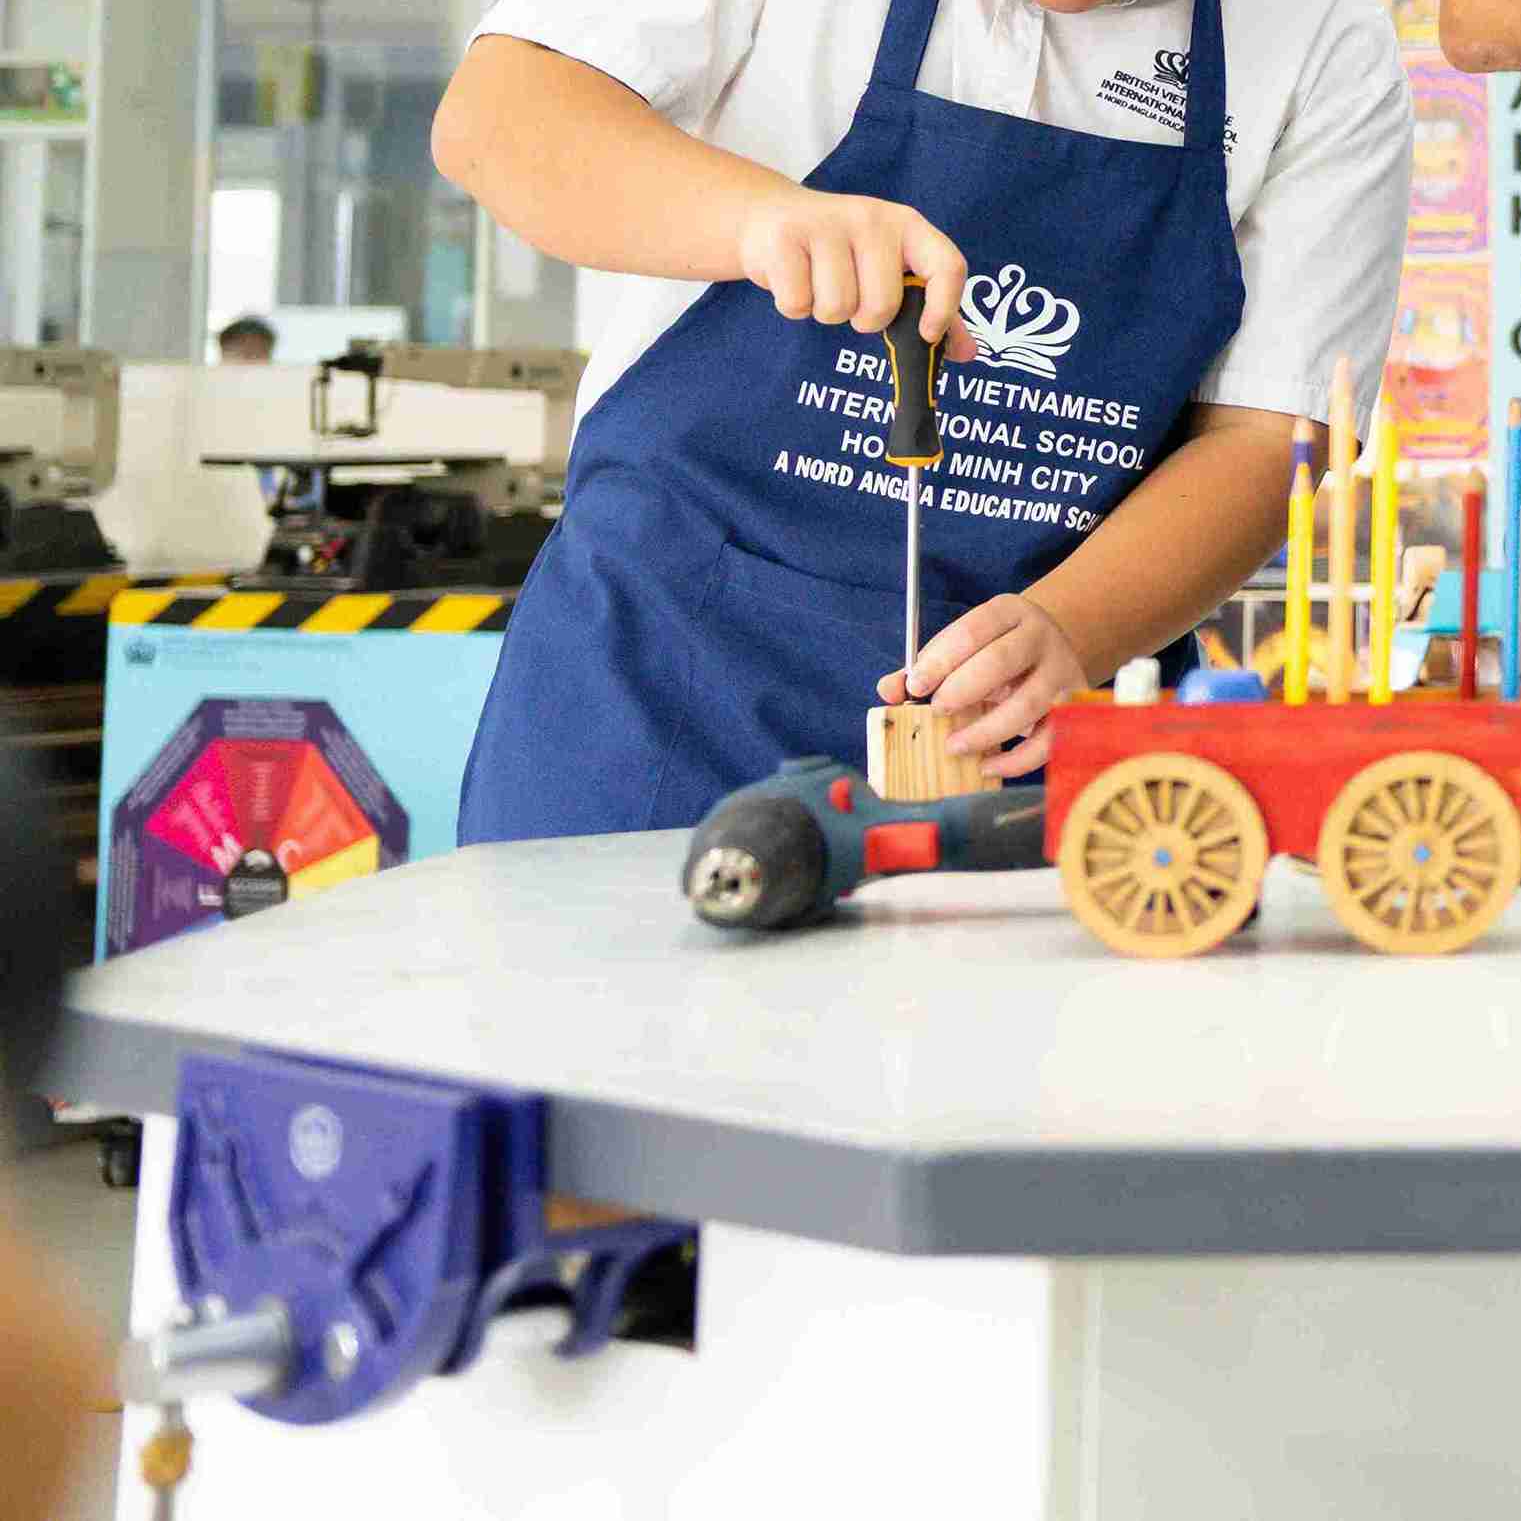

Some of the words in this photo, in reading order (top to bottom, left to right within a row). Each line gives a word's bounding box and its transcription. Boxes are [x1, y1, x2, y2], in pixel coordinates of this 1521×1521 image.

[1101, 79, 1186, 122] INTERNATIONA
[1104, 94, 1129, 110] NORD
[1128, 103, 1158, 120] ANGLIA
[1159, 117, 1185, 133] EDUCA
[1114, 70, 1160, 95] BRITISH
[835, 348, 949, 397] BRIH
[957, 374, 1141, 430] VIETNAMESE
[797, 380, 1027, 450] INTERNIONAL
[1036, 429, 1145, 471] SCHOOL
[773, 450, 790, 474] A
[794, 454, 854, 487] NORD
[857, 470, 934, 507] ANGLA
[940, 488, 1062, 525] EDUCATION
[840, 429, 886, 459] HO
[949, 452, 1024, 486] MINH
[1031, 466, 1099, 496] CITY
